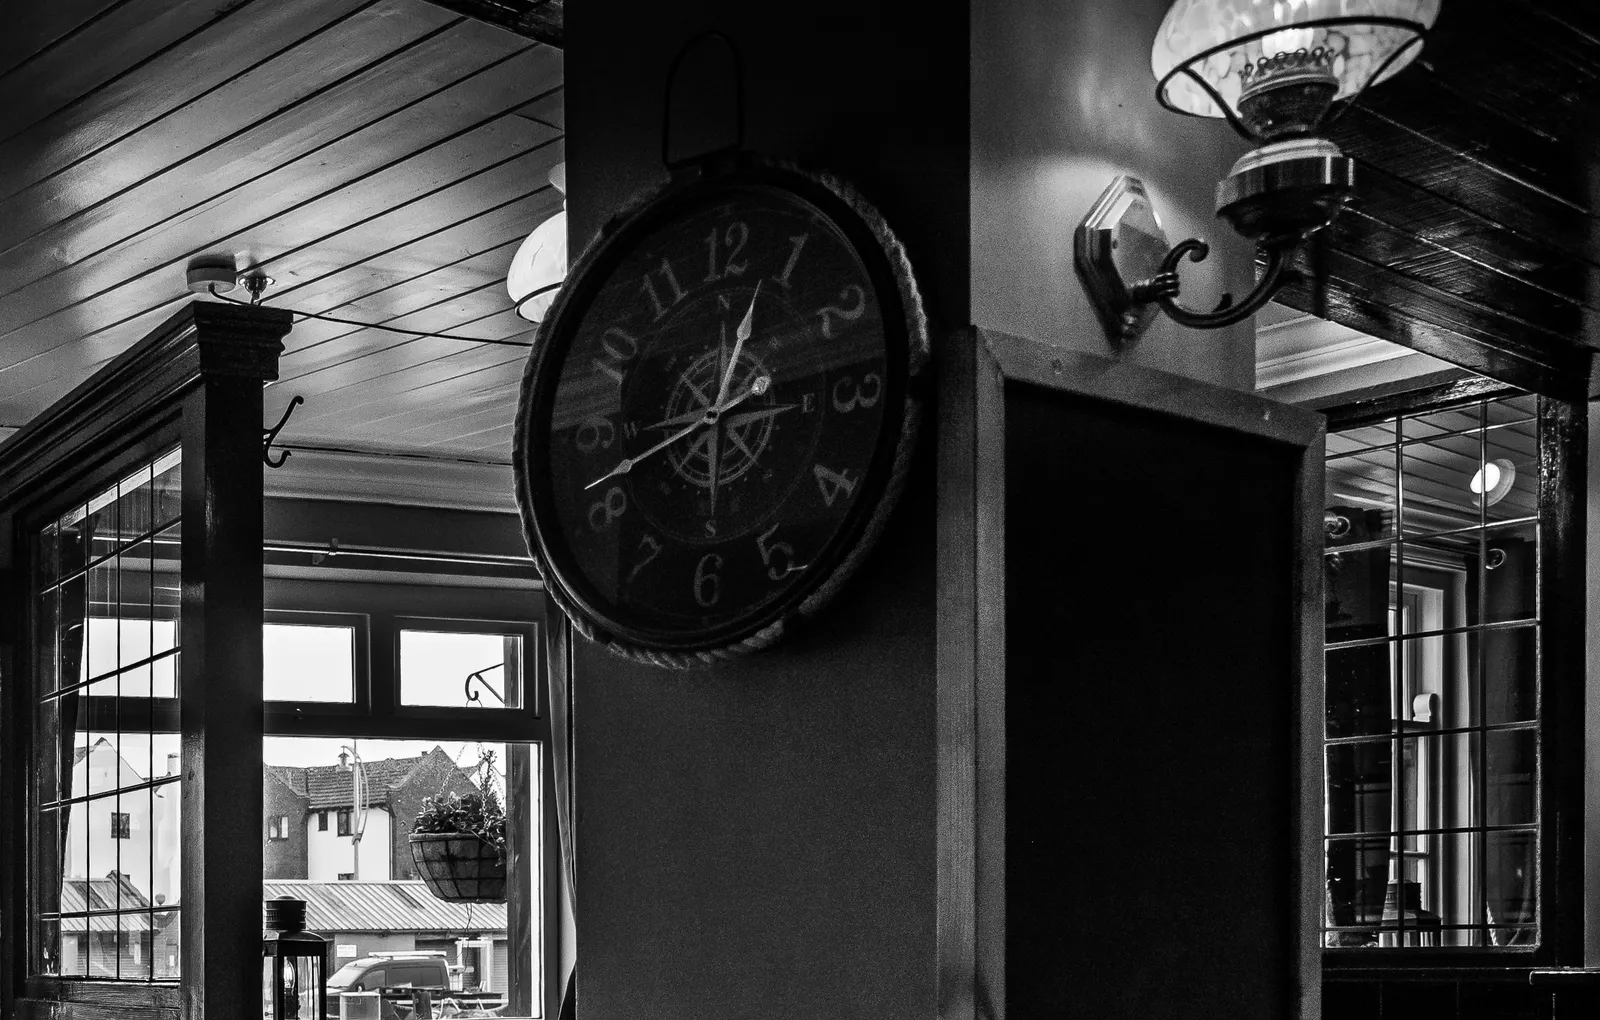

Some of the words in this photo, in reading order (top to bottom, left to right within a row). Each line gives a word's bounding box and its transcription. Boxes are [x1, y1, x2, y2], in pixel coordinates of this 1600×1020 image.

[703, 222, 750, 281] 12
[772, 233, 810, 288] 1
[639, 258, 689, 322] 11
[816, 283, 866, 339] 2
[593, 326, 638, 389] 10
[832, 373, 881, 413] 3
[575, 418, 615, 452] 9
[589, 486, 627, 533] 8
[813, 463, 859, 507] 4
[627, 533, 664, 583] 7
[756, 524, 794, 581] 5
[693, 553, 724, 607] 6
